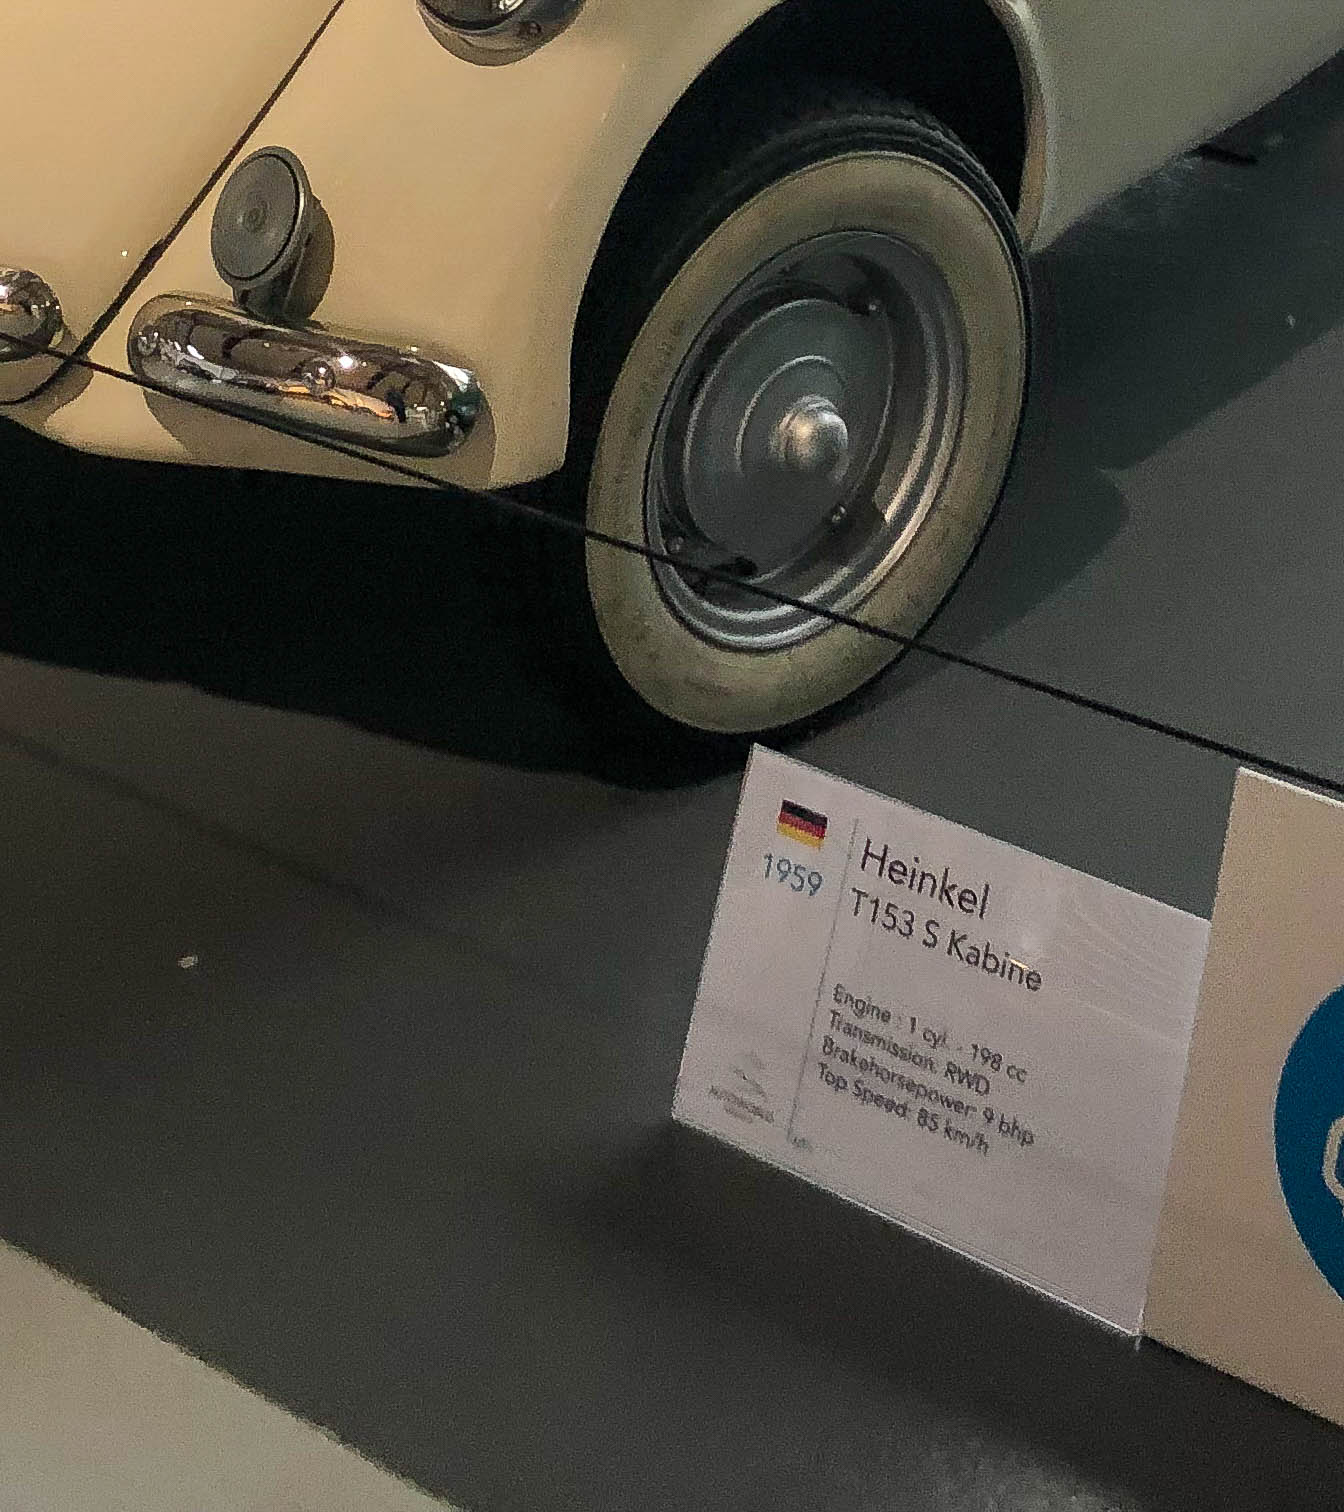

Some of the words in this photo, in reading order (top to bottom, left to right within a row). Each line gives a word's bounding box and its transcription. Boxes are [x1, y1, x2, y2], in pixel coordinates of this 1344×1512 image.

[763, 852, 824, 897] 1959
[860, 837, 991, 920] Heinkel
[851, 887, 916, 940] T153
[921, 919, 941, 950] S
[946, 929, 1043, 992] Kabine
[909, 1015, 918, 1035] 1
[971, 1042, 1004, 1072] 198
[1006, 1064, 1028, 1084] cc
[944, 1061, 991, 1097] RWD
[817, 1061, 849, 1092] Top
[916, 1107, 940, 1132] 85
[982, 1106, 996, 1125] 9
[998, 1112, 1035, 1148] bhp
